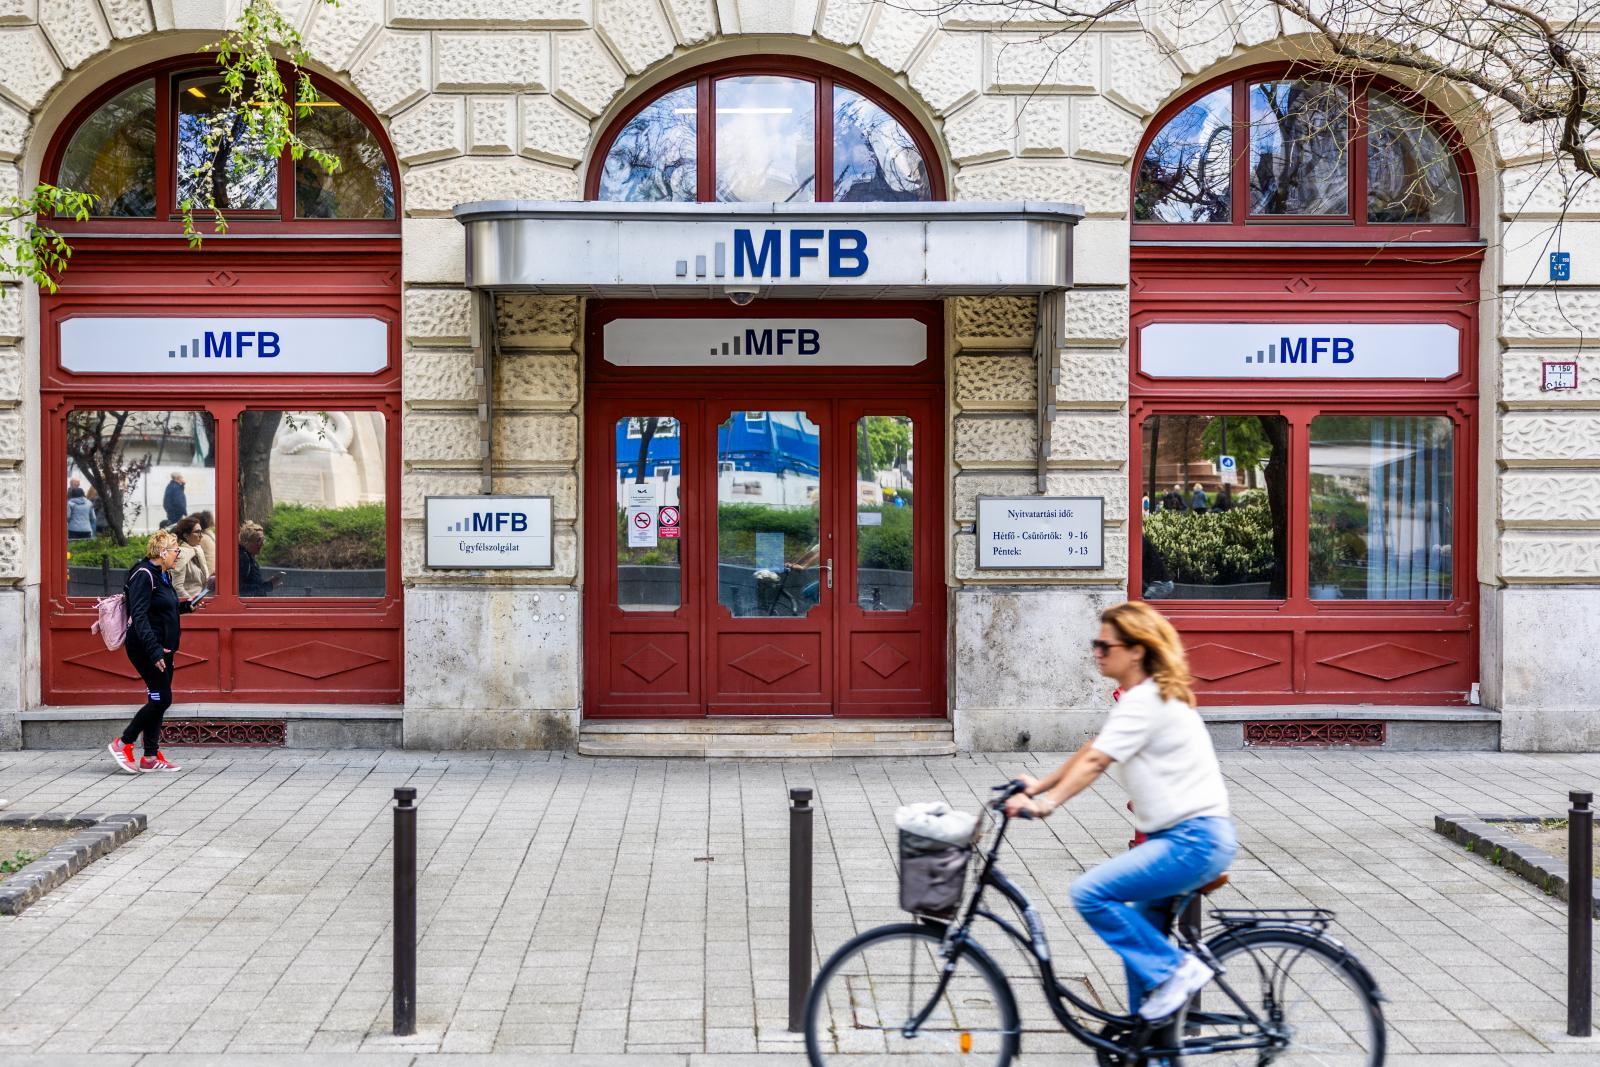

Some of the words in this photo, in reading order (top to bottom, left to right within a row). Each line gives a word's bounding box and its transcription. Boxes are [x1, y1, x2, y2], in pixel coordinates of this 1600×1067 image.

[734, 229, 868, 277] MFB
[204, 331, 280, 358] MFB
[745, 329, 821, 356] MFB
[1280, 337, 1355, 364] MFB
[472, 512, 528, 532] MFB
[1007, 509, 1056, 520] Nyitvatartási
[1058, 509, 1074, 518] idő:
[993, 531, 1016, 540] Hétfő
[1068, 531, 1074, 540] 9
[1080, 531, 1088, 540] 16
[459, 541, 519, 554] Ügyfélszolgálat
[993, 546, 1022, 556] Péntek:
[1068, 546, 1074, 555] 9
[1080, 546, 1088, 555] 13
